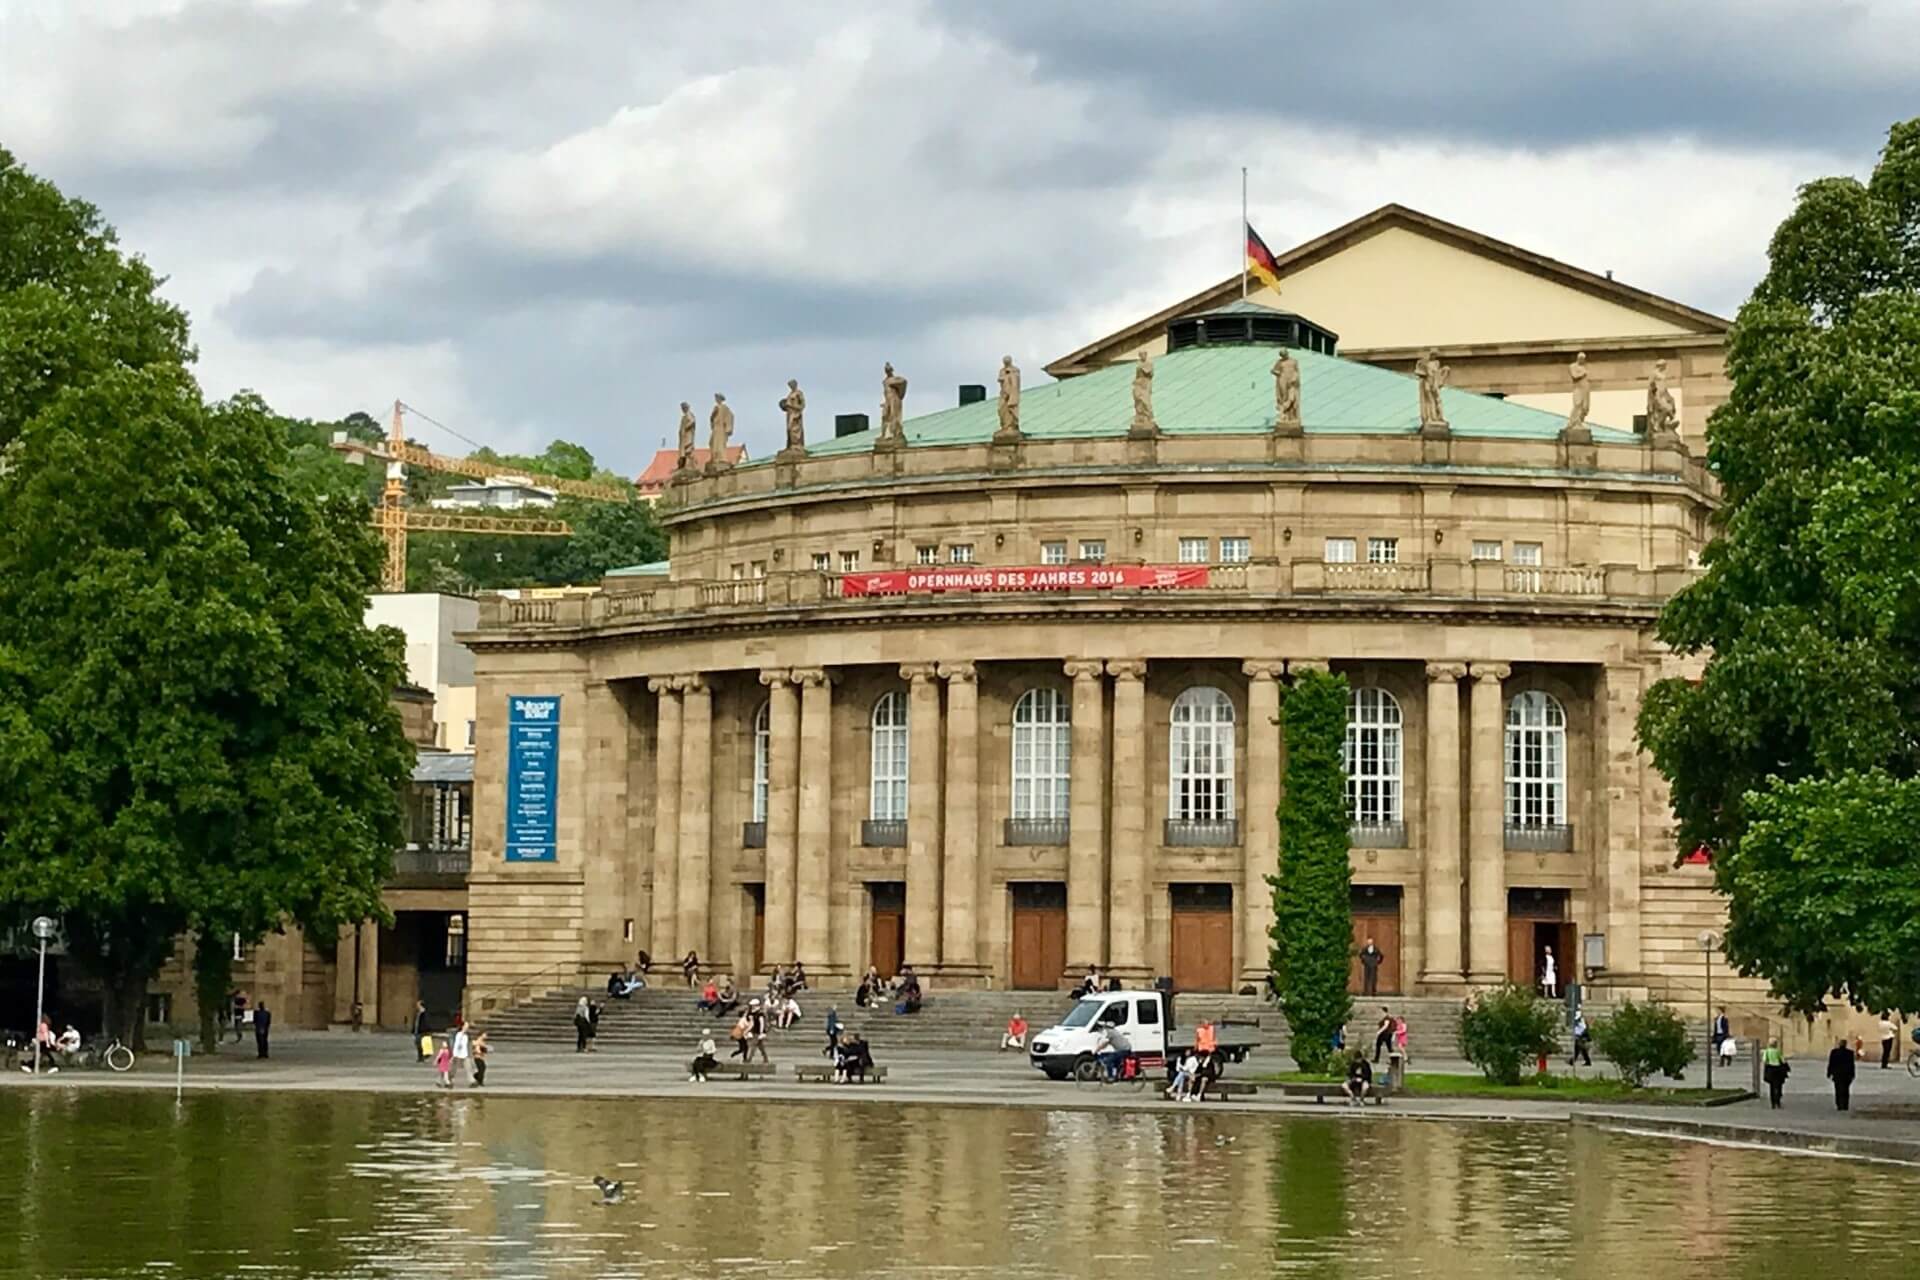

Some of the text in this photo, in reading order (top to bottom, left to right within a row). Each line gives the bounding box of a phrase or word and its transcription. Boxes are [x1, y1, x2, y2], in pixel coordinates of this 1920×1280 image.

[908, 573, 993, 588] OPERNHAUS
[998, 572, 1026, 586] DES
[1030, 571, 1086, 586] JAHRES
[1091, 570, 1125, 584] 2016
